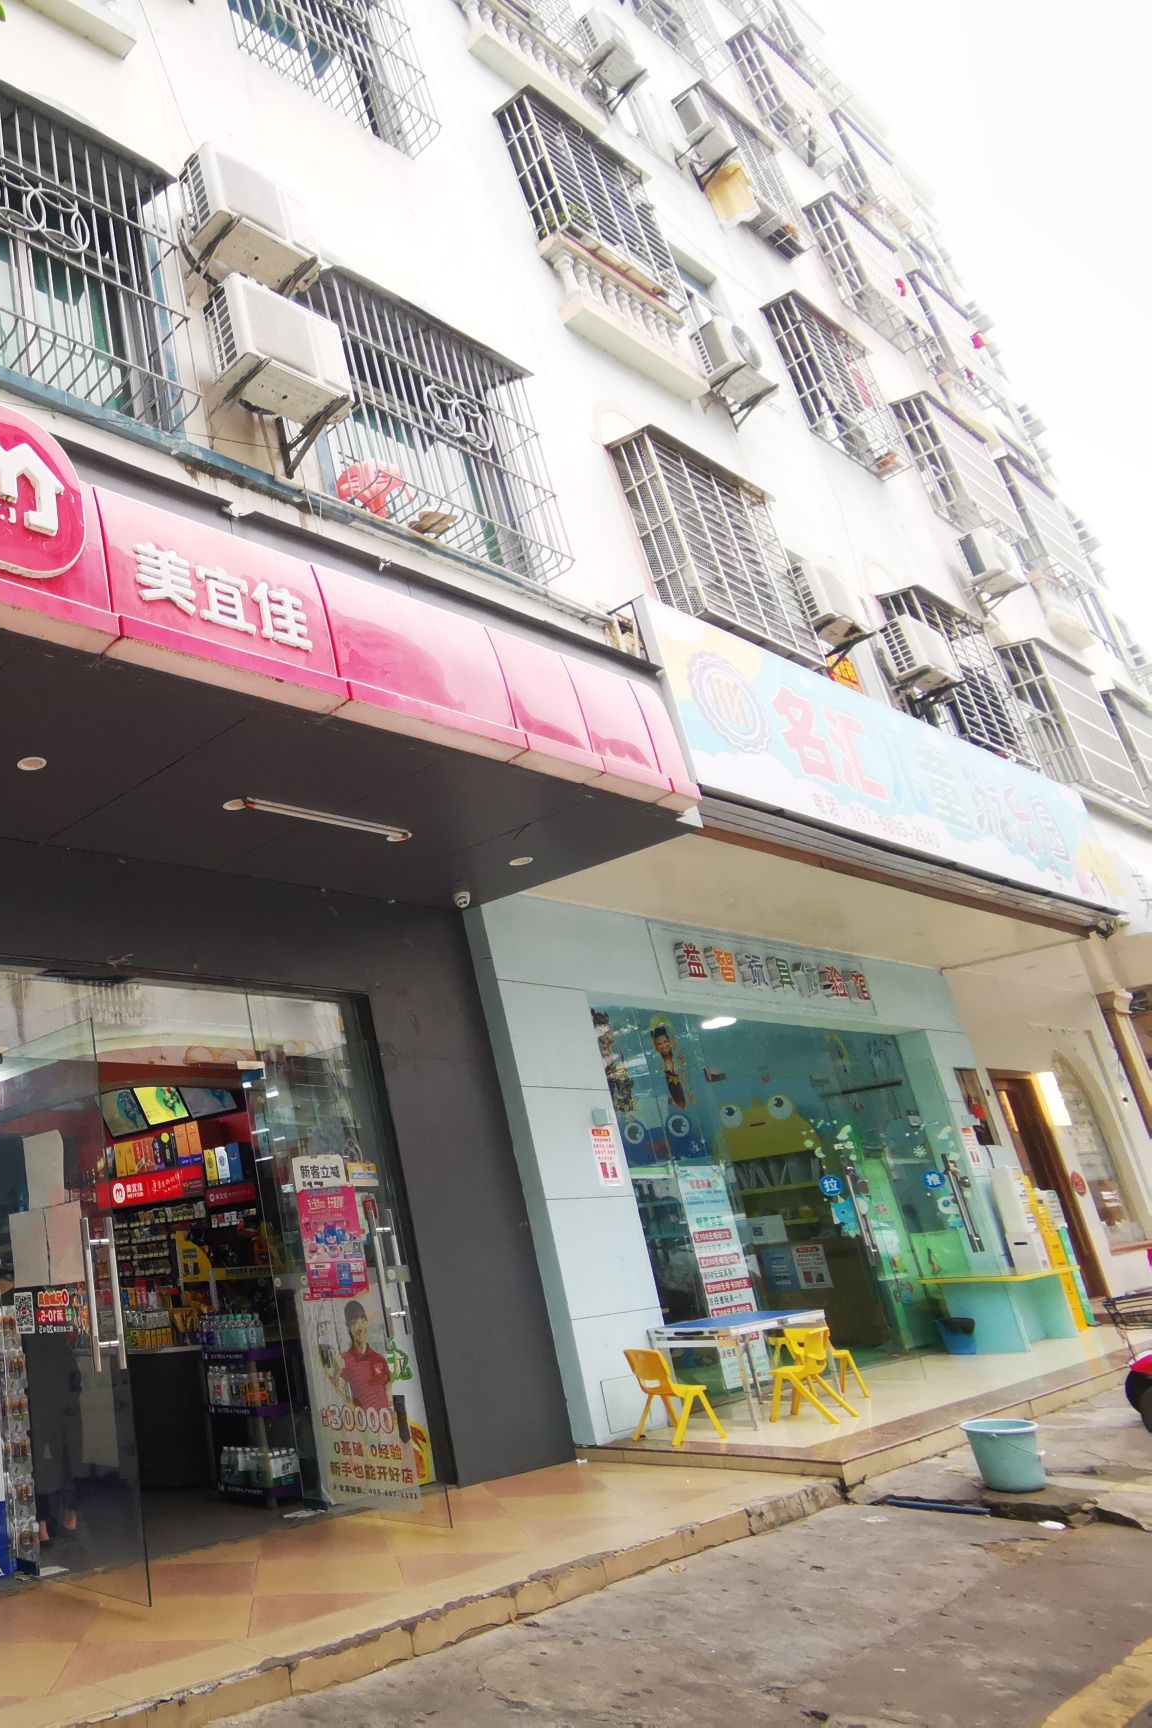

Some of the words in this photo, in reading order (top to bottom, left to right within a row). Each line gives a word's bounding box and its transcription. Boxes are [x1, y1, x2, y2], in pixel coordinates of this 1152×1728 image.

[133, 542, 313, 652] 美宜佳
[772, 683, 1072, 864] 名汇儿童游乐园
[299, 1165, 341, 1179] 新客立减
[926, 1172, 942, 1186] 推
[823, 1178, 840, 1192] 拉
[327, 1403, 394, 1434] 30000
[333, 1440, 364, 1457] 0基础
[370, 1443, 403, 1460] 0经验
[329, 1461, 414, 1484] 新手也能开好店
